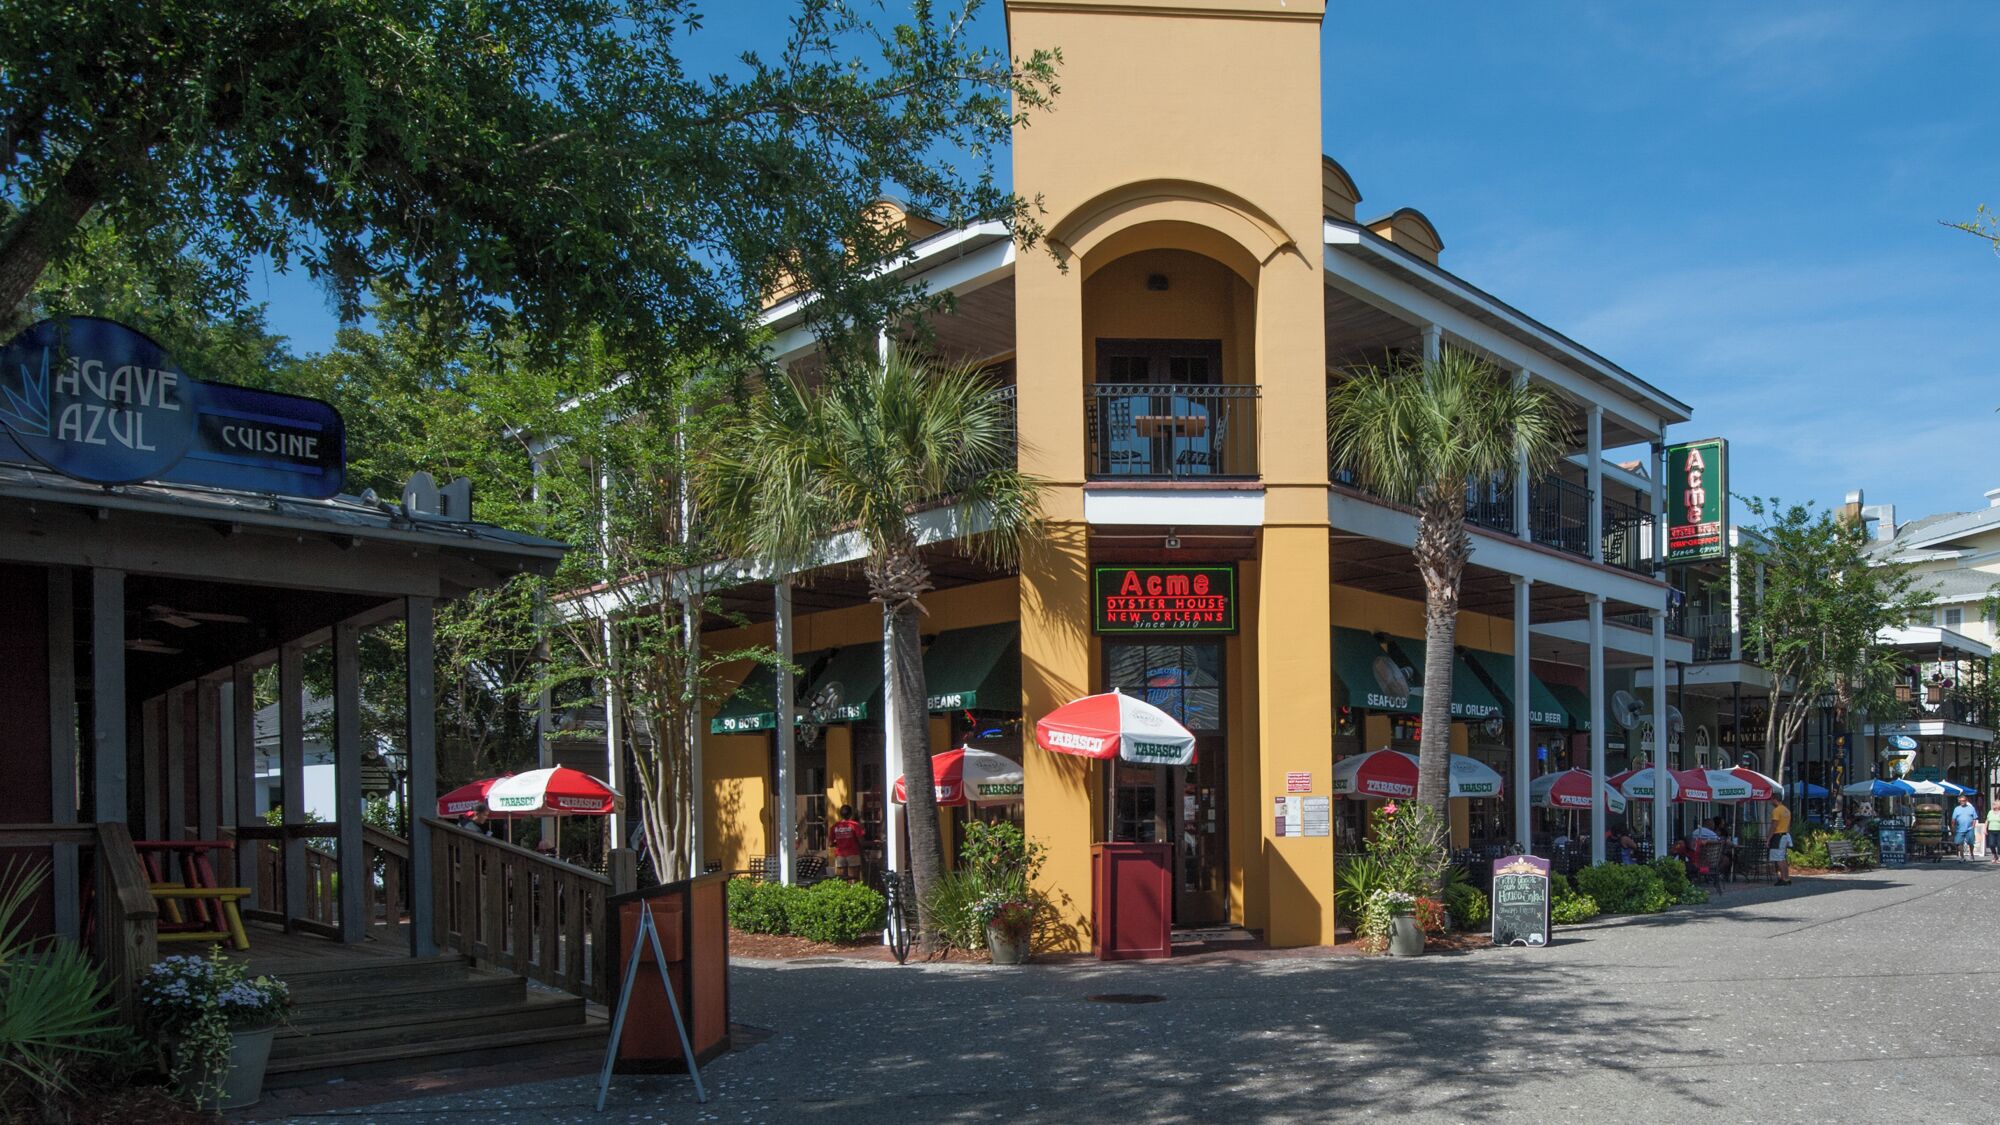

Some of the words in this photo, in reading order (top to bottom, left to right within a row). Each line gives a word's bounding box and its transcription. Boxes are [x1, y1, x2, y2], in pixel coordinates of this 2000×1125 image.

[55, 356, 180, 411] AGAVE
[57, 403, 156, 452] AZUL
[222, 425, 319, 459] CUISINE
[1120, 570, 1209, 595] Acme
[1107, 598, 1165, 609] OYSTER
[1107, 612, 1140, 622] NEW
[1152, 612, 1223, 622] ORLEANS
[1133, 620, 1166, 628] Since
[1173, 620, 1199, 628] 1910
[1367, 693, 1408, 708] SEAFOOD
[1450, 703, 1463, 714] EW
[724, 718, 736, 730] PO
[739, 716, 760, 729] BOYS
[1529, 711, 1542, 722] OLD
[1545, 712, 1561, 724] BEER
[1048, 730, 1105, 752] TABASCO
[1134, 742, 1182, 758] TABASCO
[1367, 780, 1414, 796] TABASCO
[500, 796, 536, 807] TABASCO
[558, 797, 603, 809] TABASCO
